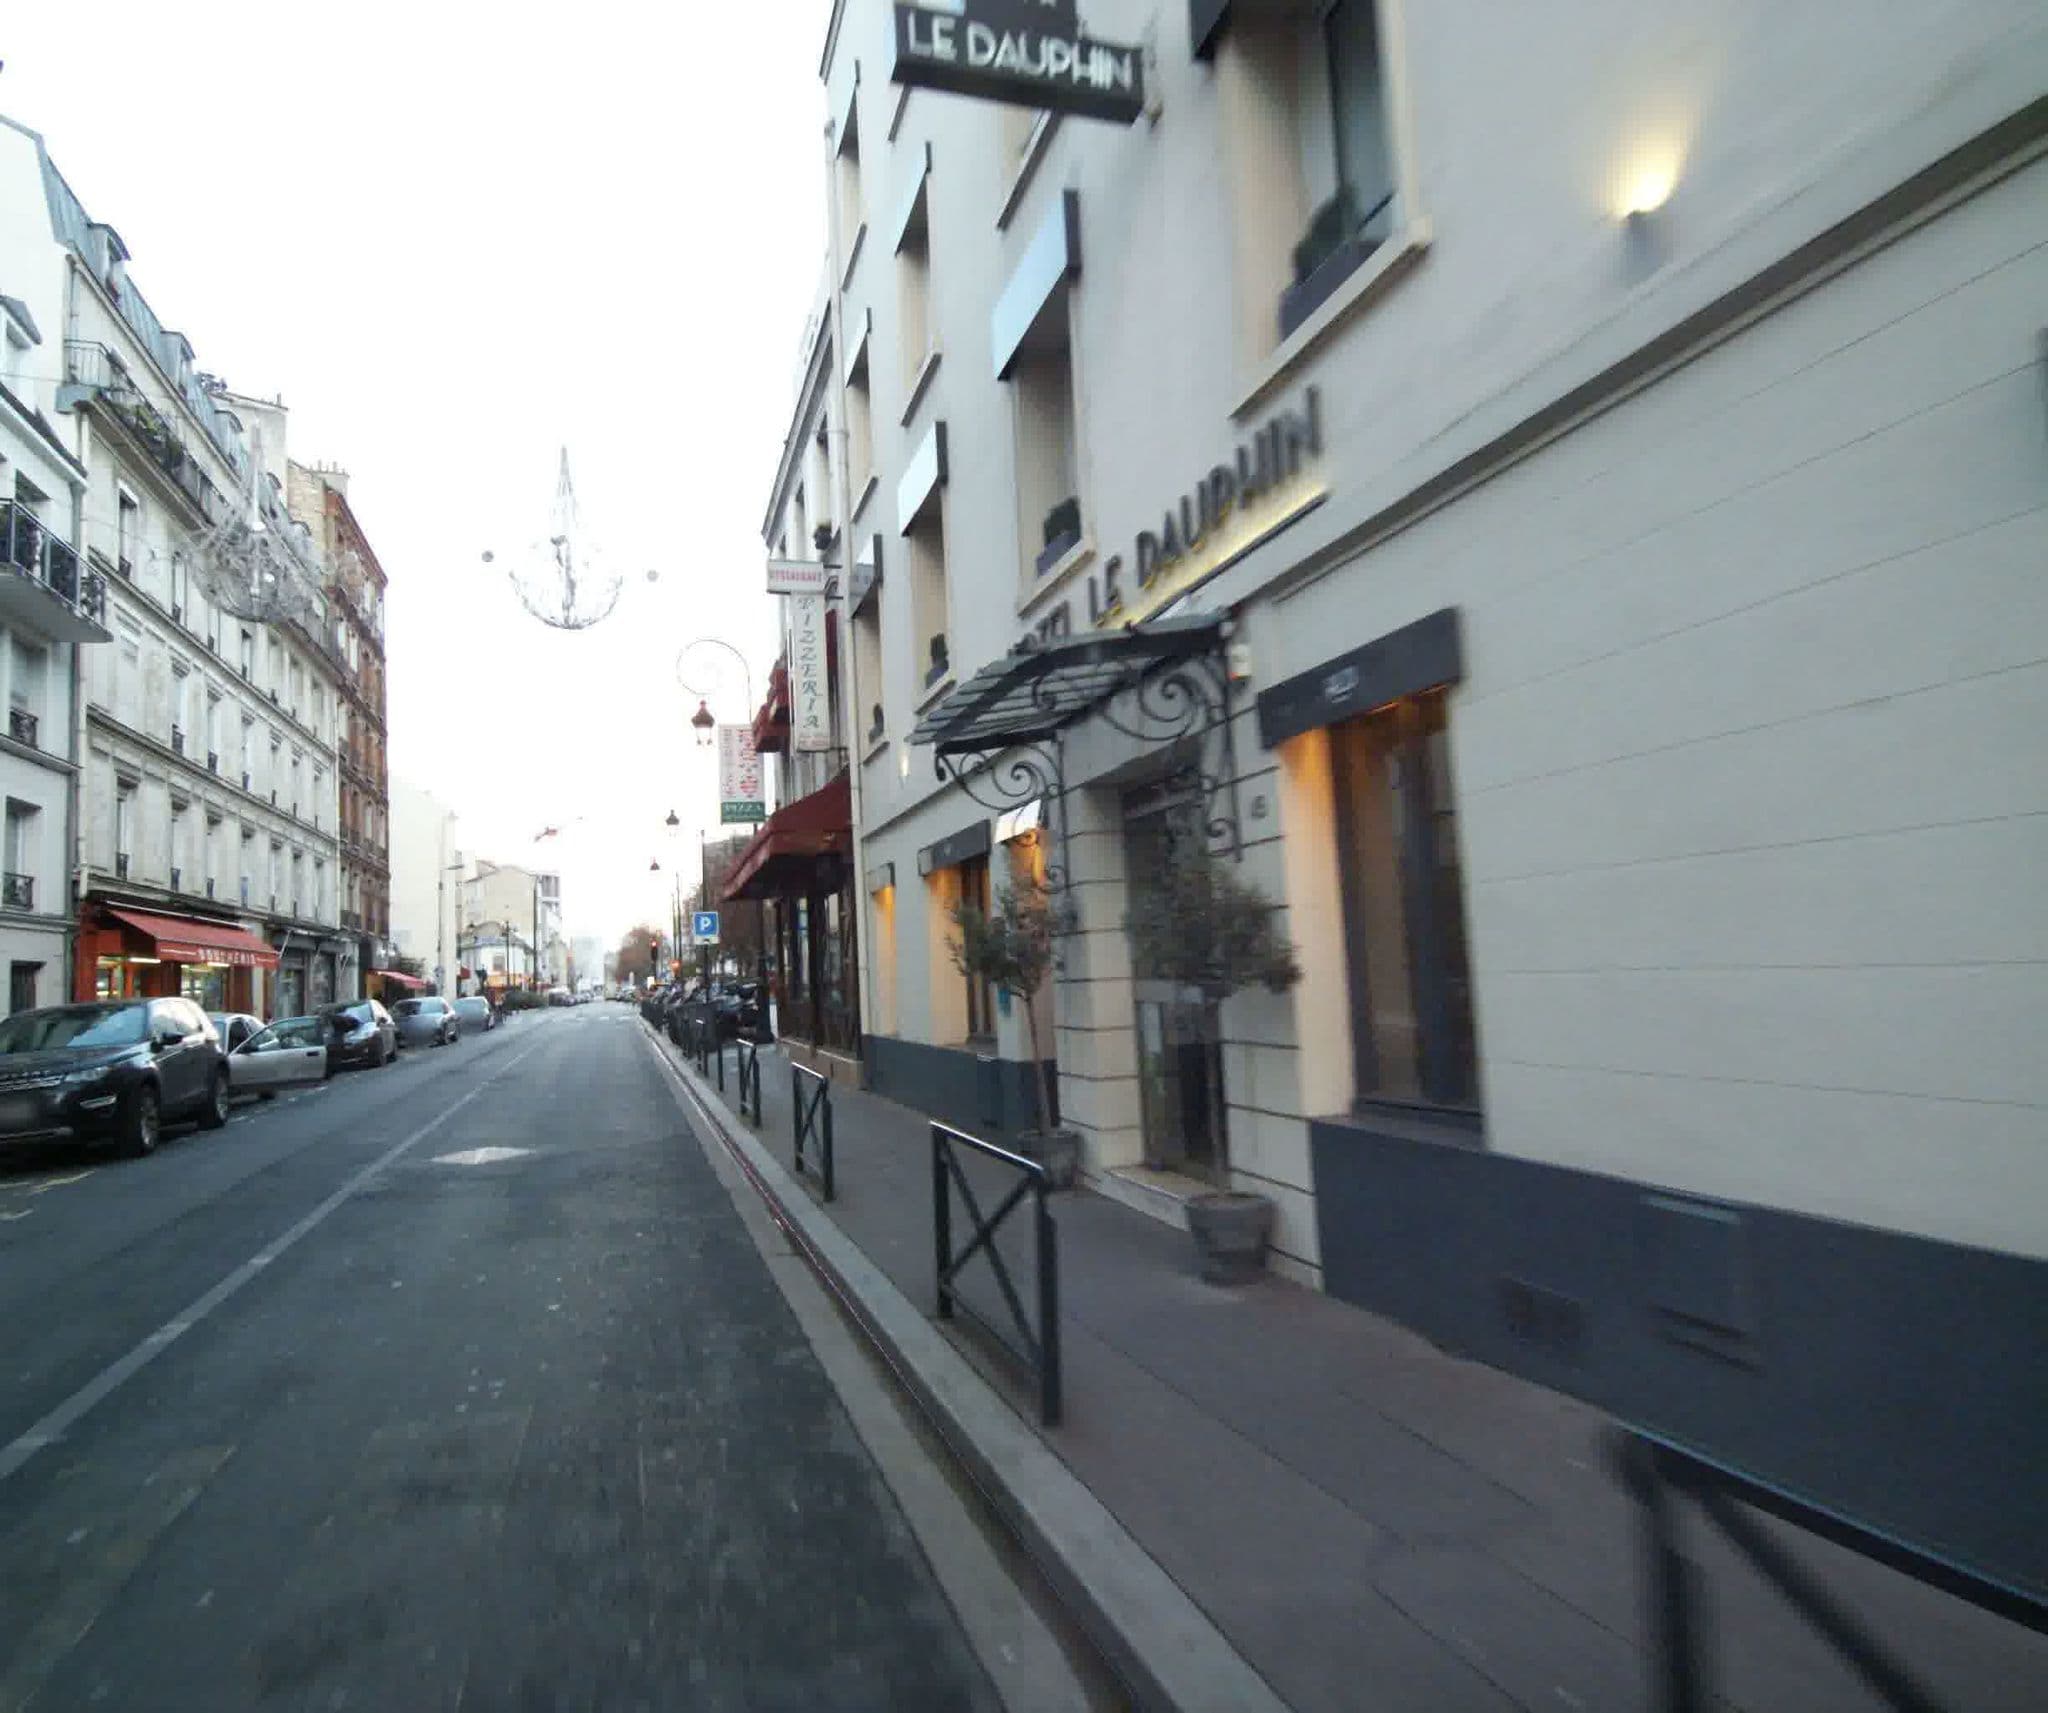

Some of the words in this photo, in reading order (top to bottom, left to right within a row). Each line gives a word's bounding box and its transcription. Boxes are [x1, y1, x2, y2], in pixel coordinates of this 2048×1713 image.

[907, 10, 957, 61] LE
[966, 22, 1133, 91] DAUPHIN
[799, 597, 822, 729] PIZZERIA
[699, 916, 712, 931] P
[197, 948, 257, 965] BOUCHERIE
